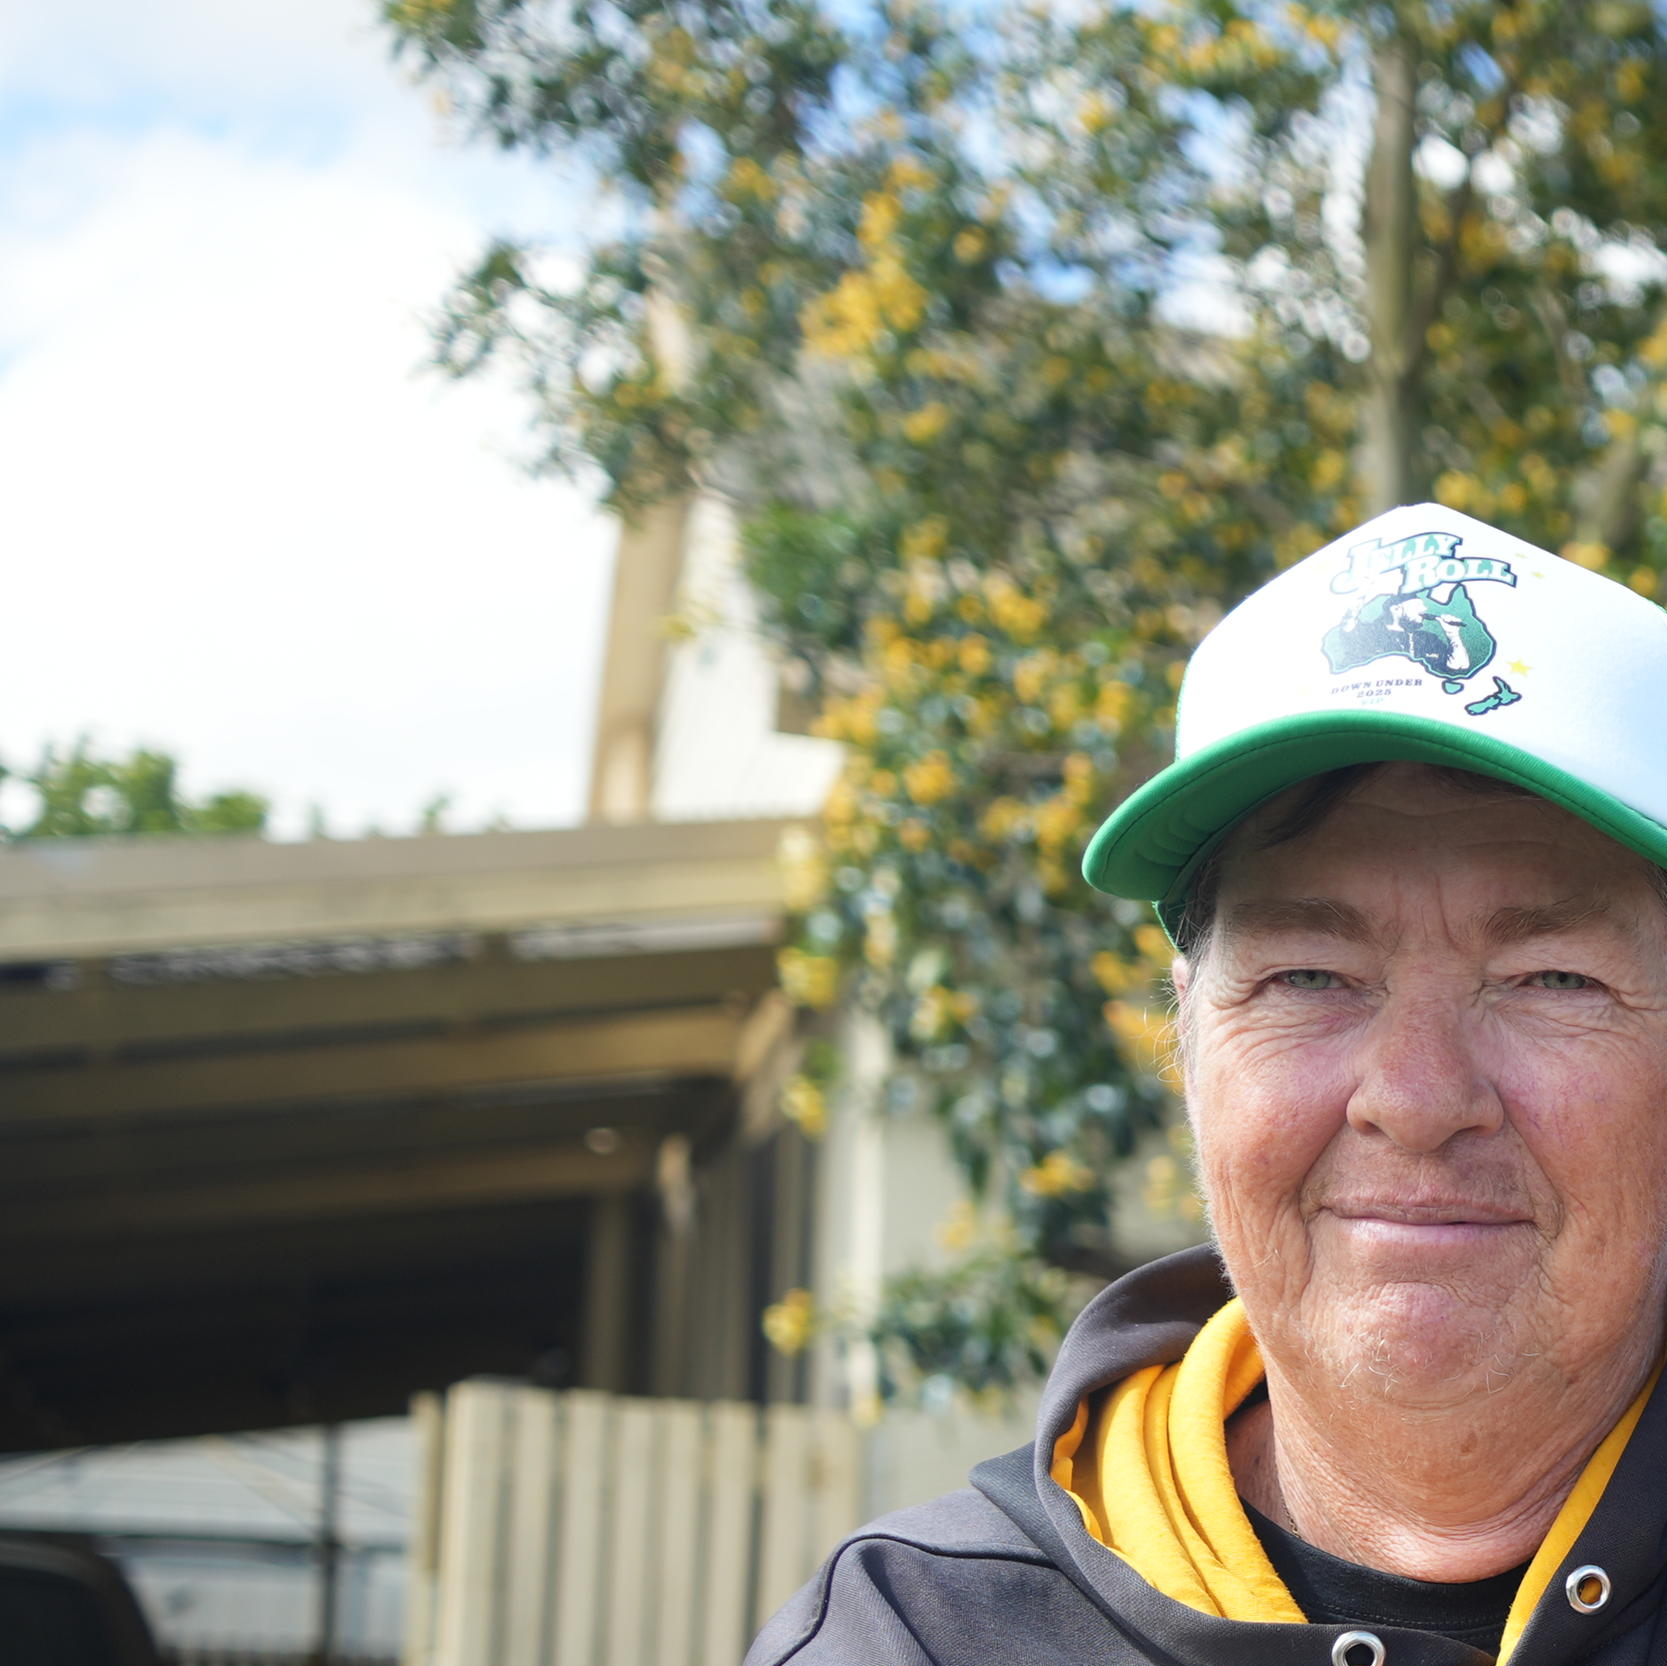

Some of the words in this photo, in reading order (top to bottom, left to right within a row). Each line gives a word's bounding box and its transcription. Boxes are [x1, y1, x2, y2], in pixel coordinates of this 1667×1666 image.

[1399, 555, 1517, 594] ROLL
[1331, 681, 1372, 695] DOWN
[1376, 678, 1423, 688] UNDER
[1356, 688, 1392, 699] 2025
